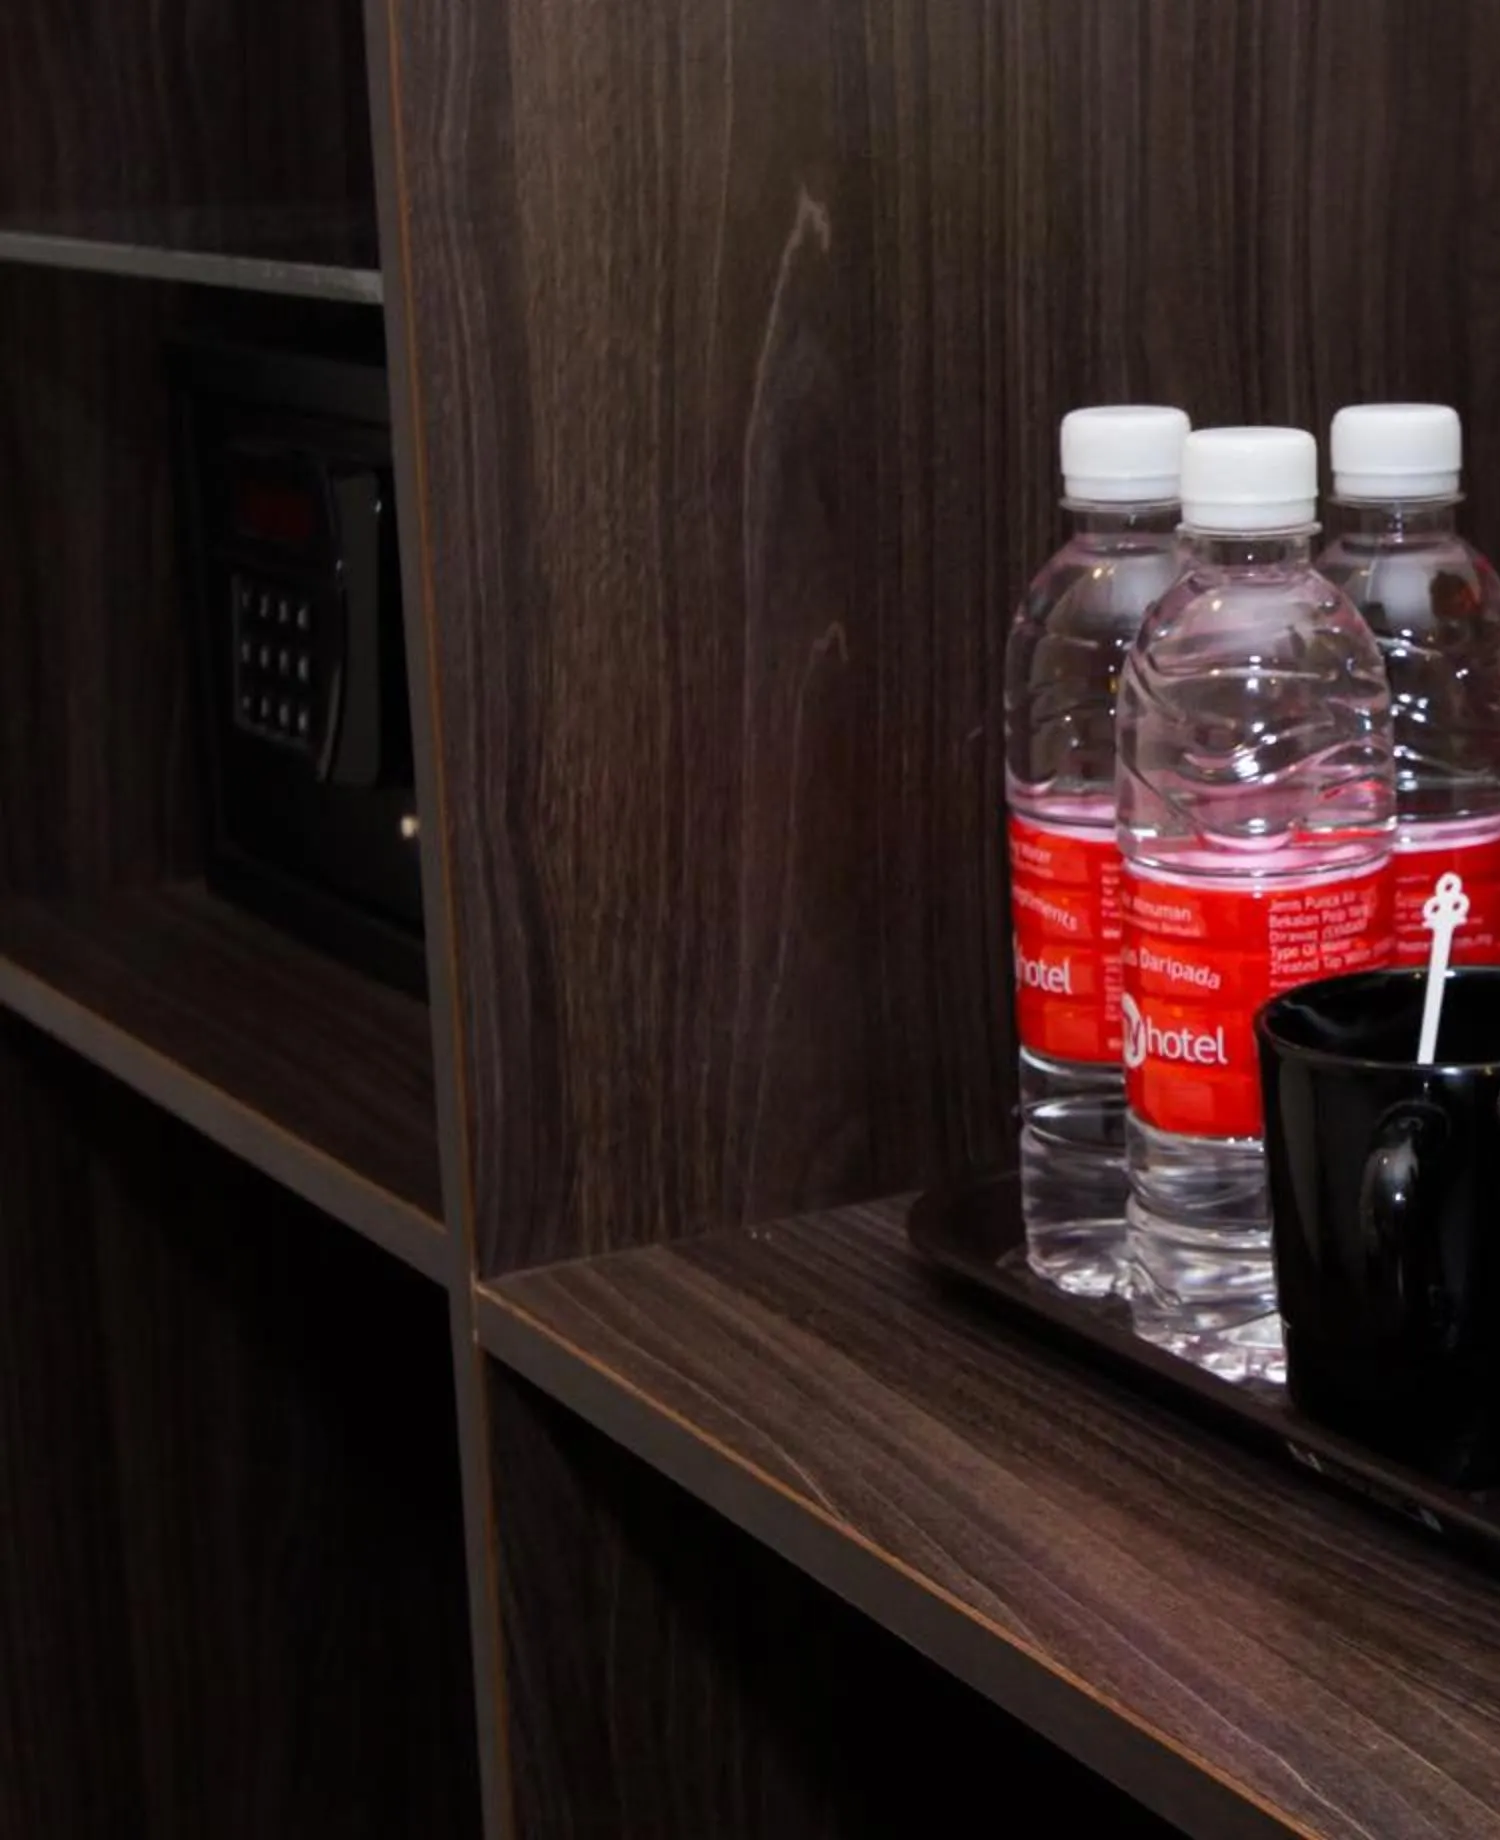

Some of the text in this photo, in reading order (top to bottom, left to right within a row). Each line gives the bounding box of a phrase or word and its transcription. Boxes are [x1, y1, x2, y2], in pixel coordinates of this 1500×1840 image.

[1139, 946, 1222, 990] Daripada
[1269, 944, 1300, 961] Type
[1146, 1015, 1229, 1065] hotel
